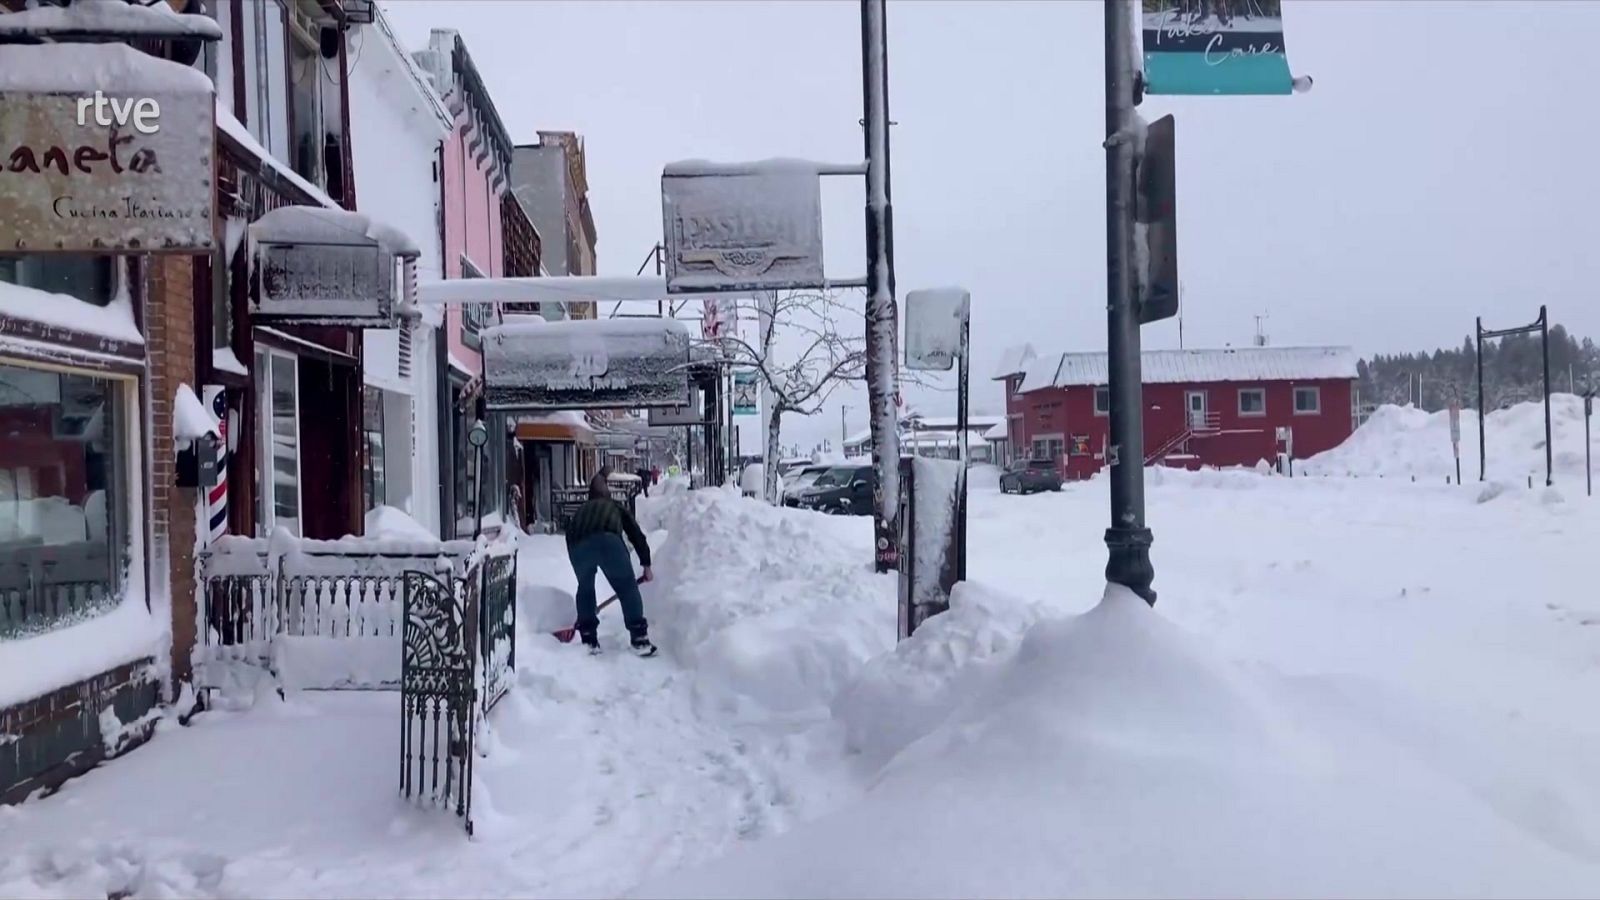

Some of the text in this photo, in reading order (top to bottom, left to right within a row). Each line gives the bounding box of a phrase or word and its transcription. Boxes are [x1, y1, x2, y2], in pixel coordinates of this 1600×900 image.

[1151, 7, 1216, 45] Take
[1204, 33, 1279, 66] Care
[0, 123, 163, 176] aneta
[52, 195, 119, 219] Cucina
